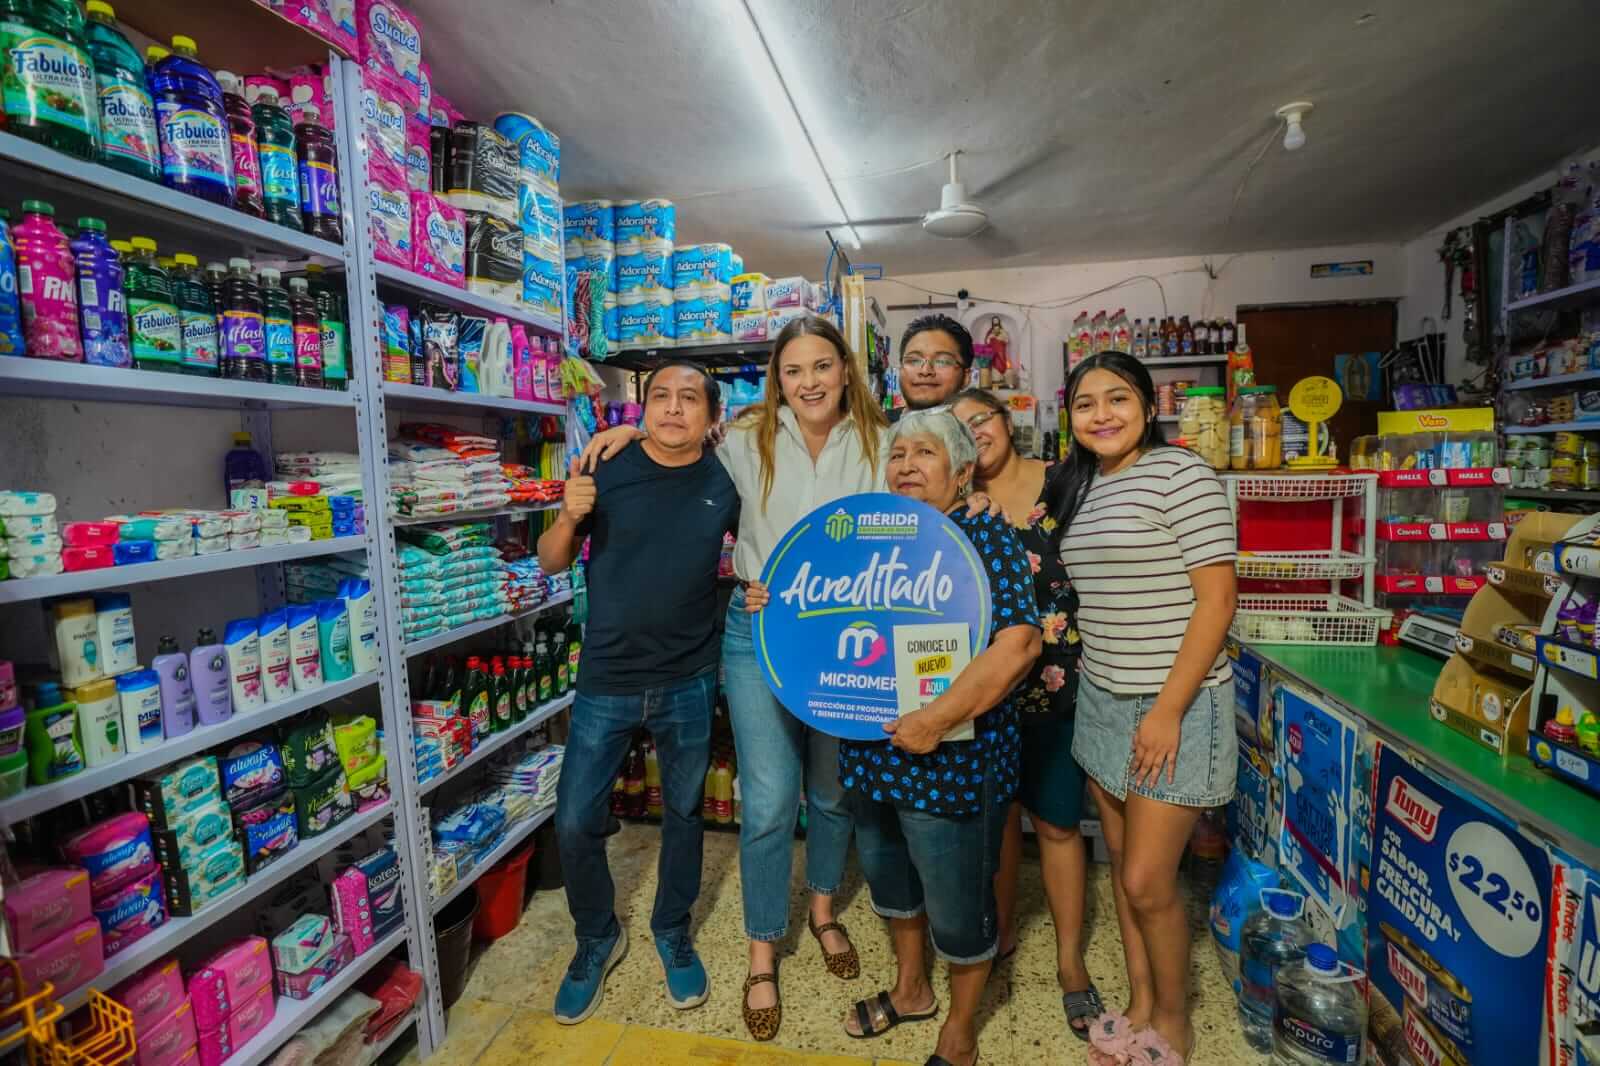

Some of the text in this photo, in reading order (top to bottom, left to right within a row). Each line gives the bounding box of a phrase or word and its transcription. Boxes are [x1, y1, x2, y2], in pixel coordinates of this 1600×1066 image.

[373, 12, 420, 54] Suavel
[11, 50, 91, 80] Fabuloso
[166, 122, 226, 144] Fabuloso
[617, 215, 658, 227] Adorable
[620, 265, 660, 277] Adorable
[677, 260, 717, 273] Adorable
[621, 316, 661, 327] Adorable
[678, 310, 720, 323] Adorable
[857, 511, 919, 526] MÉRIDA
[780, 546, 953, 611] Acreditado
[907, 639, 958, 653] CONOCE LO
[918, 660, 946, 673] NUEVO
[808, 700, 846, 710] DIRECCIÓN
[855, 705, 898, 715] PROSPERID
[229, 748, 271, 775] always
[1394, 777, 1436, 836] Tuny
[1383, 824, 1402, 849] POR
[1381, 838, 1433, 896] SABOR,
[1378, 858, 1453, 938] FRESCURA
[1376, 877, 1439, 943] CALIDAD
